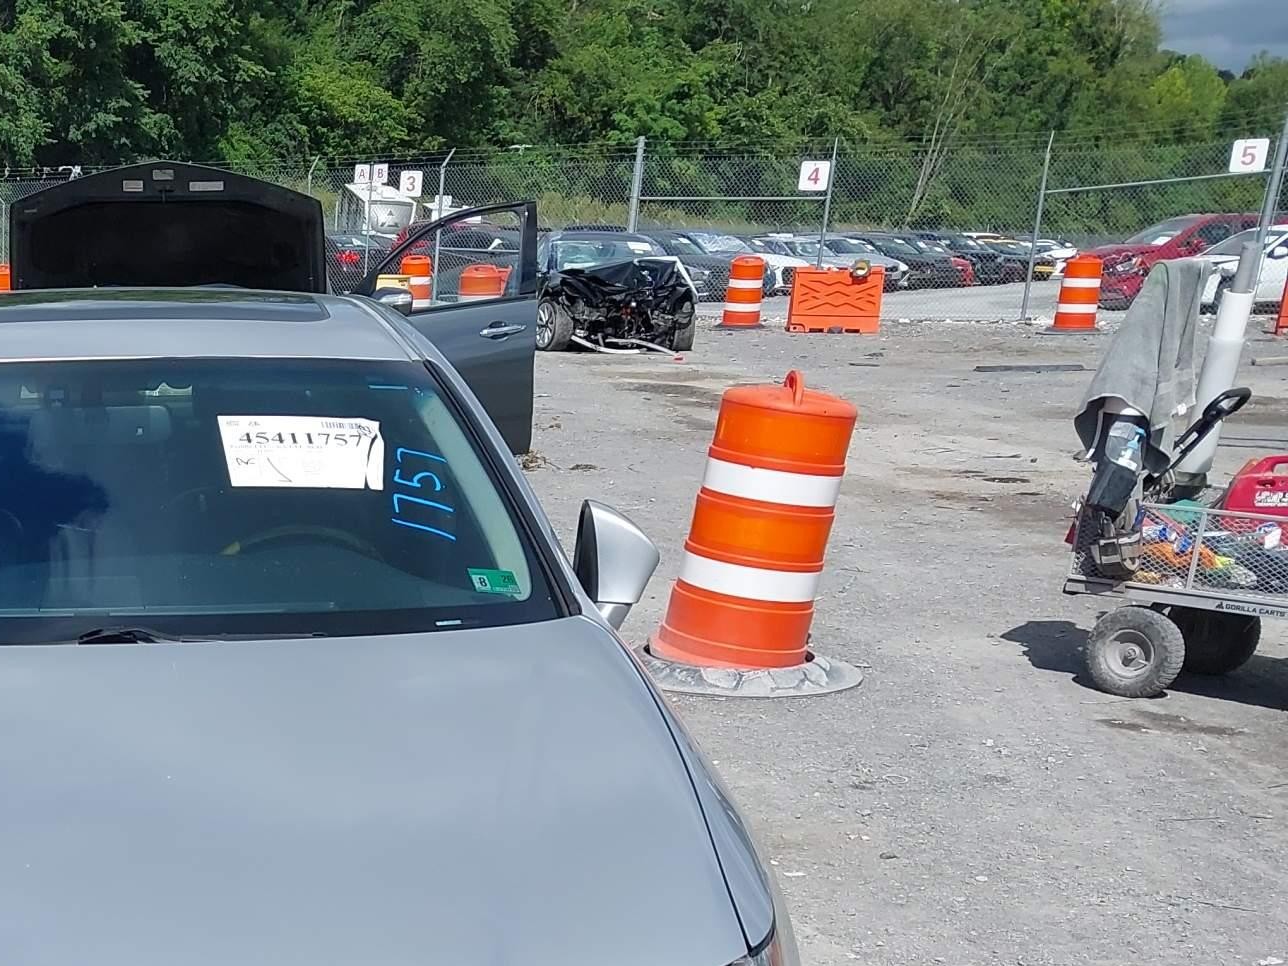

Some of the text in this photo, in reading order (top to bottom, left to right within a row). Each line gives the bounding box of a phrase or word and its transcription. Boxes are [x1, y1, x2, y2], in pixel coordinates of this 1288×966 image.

[1240, 145, 1257, 166] 5
[358, 168, 366, 179] A
[377, 168, 384, 179] B
[807, 167, 820, 185] 4
[406, 176, 416, 192] 3
[239, 432, 362, 447] 45411757
[391, 448, 457, 541] 1757
[1225, 603, 1286, 617] GORILLA CARTS
